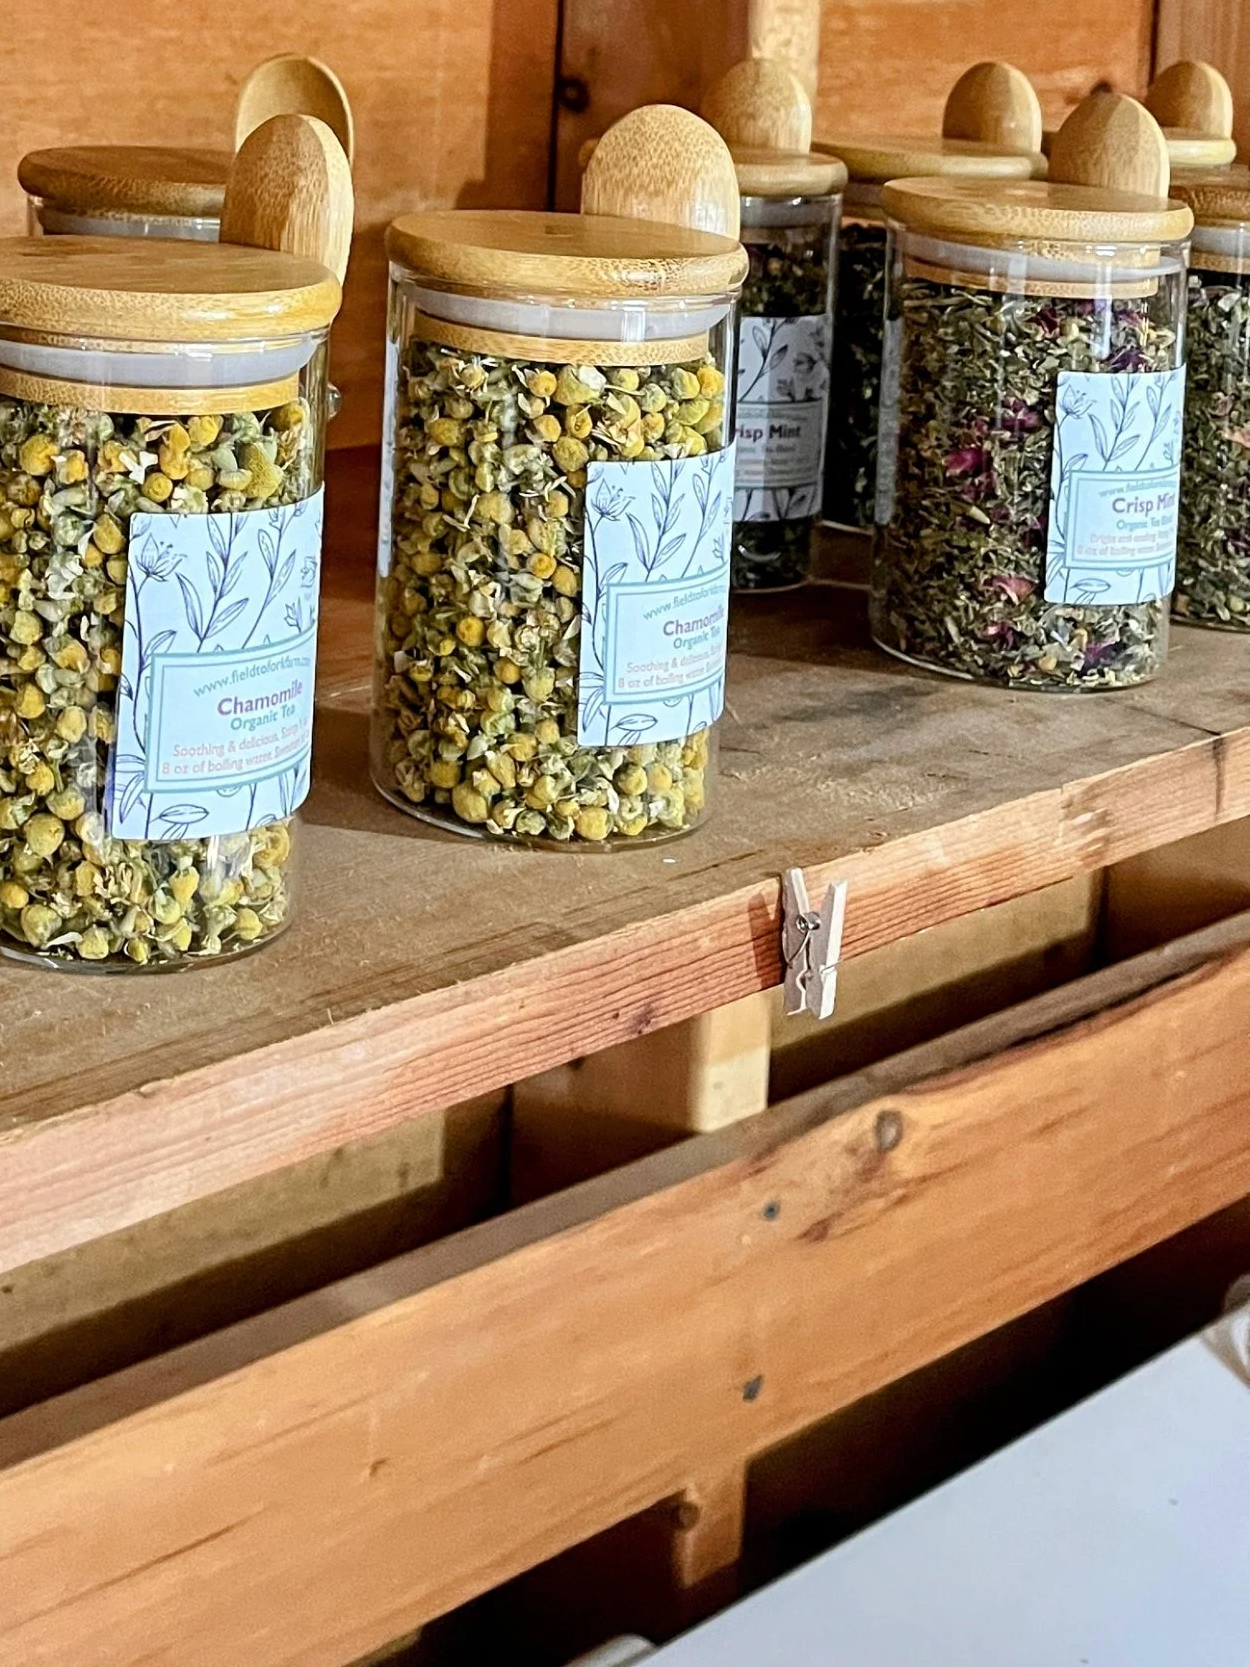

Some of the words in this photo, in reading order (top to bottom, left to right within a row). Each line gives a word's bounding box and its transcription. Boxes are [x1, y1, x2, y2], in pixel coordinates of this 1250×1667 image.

[736, 424, 763, 443] risp
[1112, 496, 1154, 517] Crisp
[217, 679, 303, 716] Chamomile
[230, 709, 278, 732] Organic
[282, 703, 296, 719] Tea
[173, 742, 225, 758] Soothing
[228, 740, 236, 752] &
[162, 763, 170, 775] 8
[174, 764, 189, 774] oz
[192, 760, 206, 774] of
